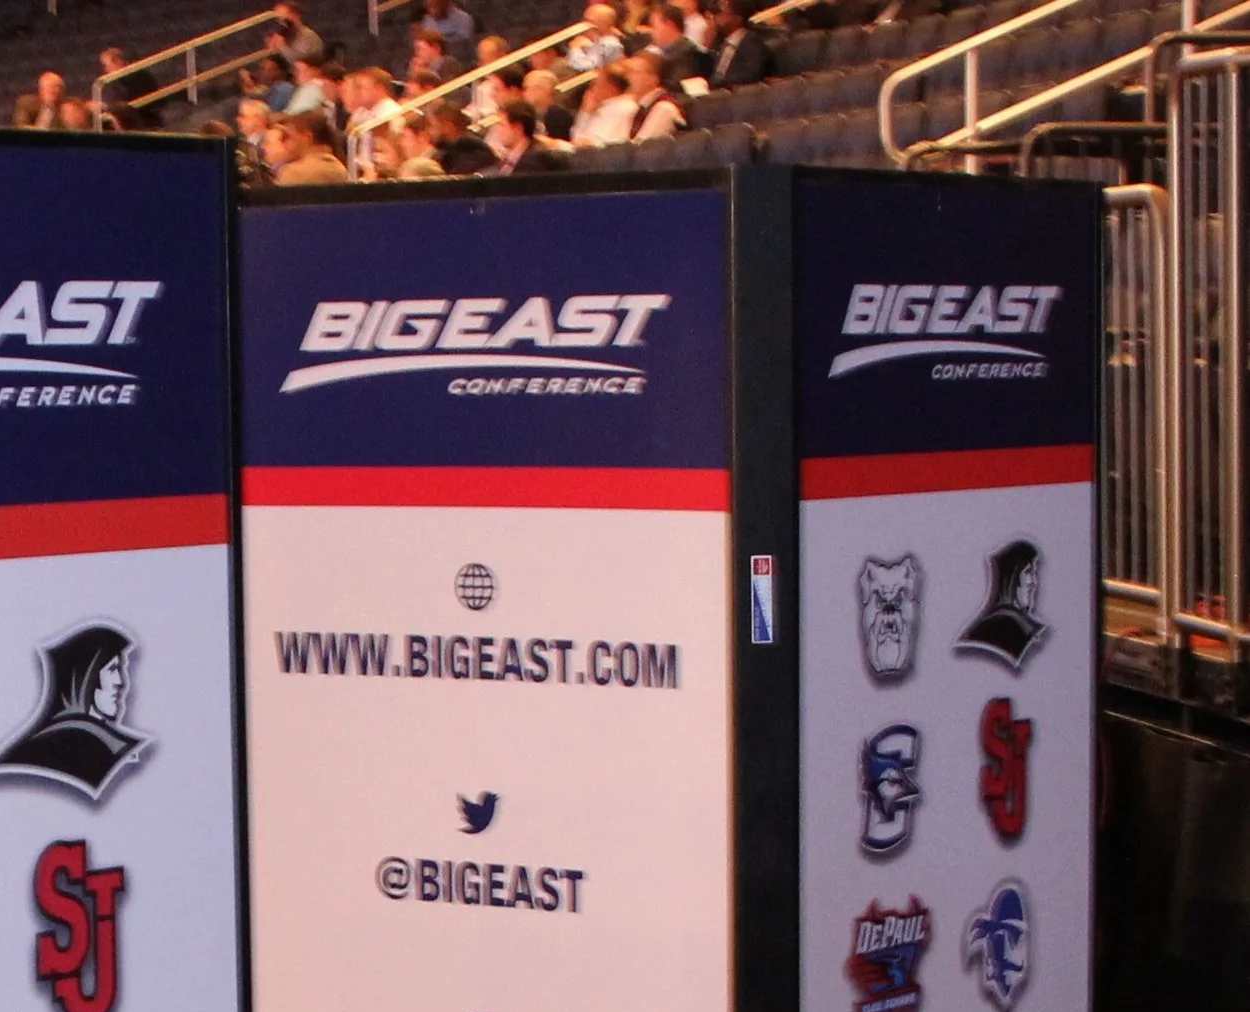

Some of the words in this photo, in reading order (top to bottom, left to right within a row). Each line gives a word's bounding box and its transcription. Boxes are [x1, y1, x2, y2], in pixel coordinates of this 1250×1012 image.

[448, 377, 645, 395] CONFERENCE
[931, 362, 1044, 380] CONFERENCE
[274, 631, 679, 688] WWW.BIGEAST.COM
[375, 856, 584, 913] @BIGEAST
